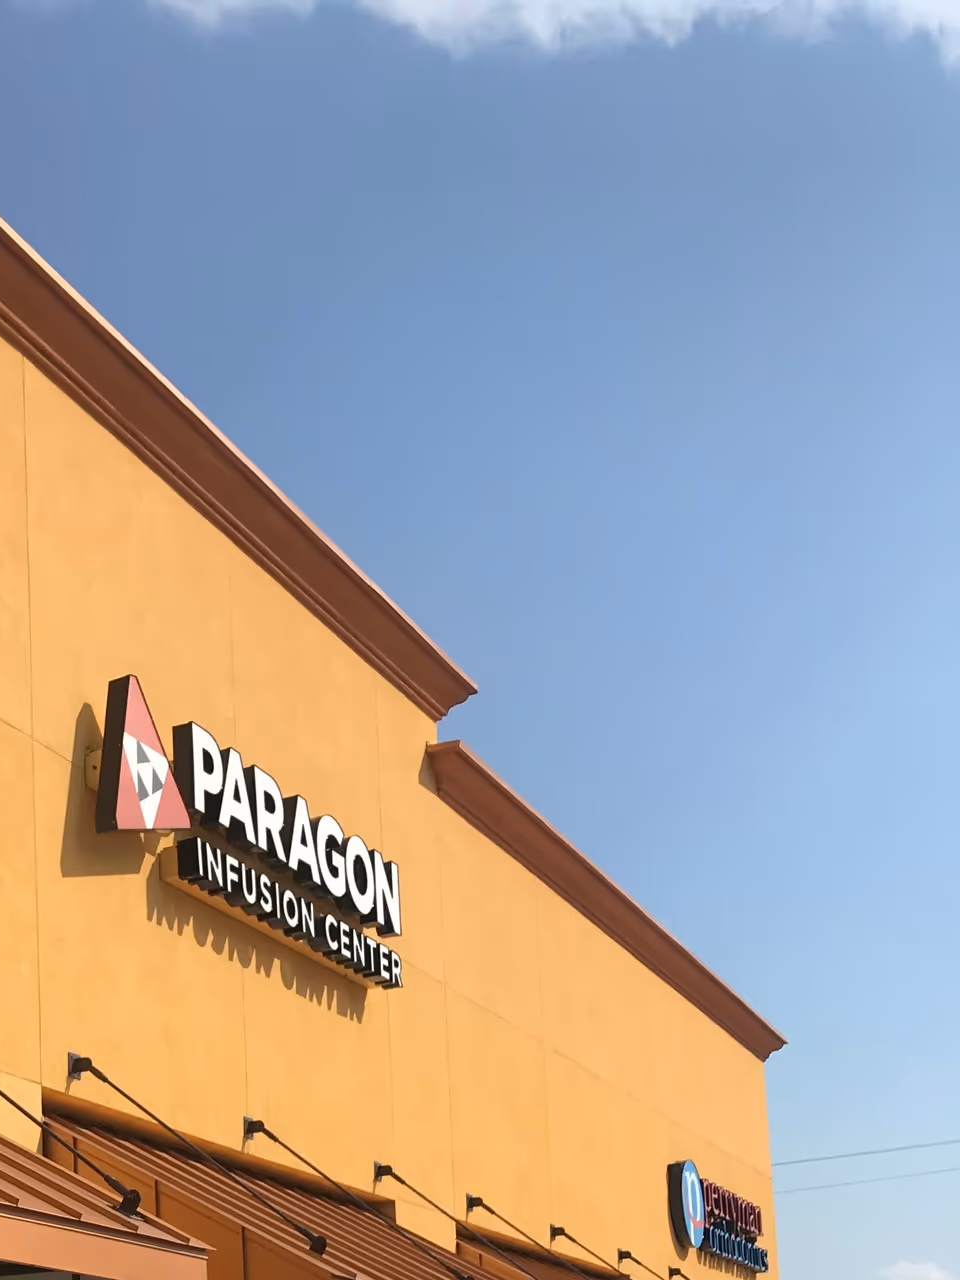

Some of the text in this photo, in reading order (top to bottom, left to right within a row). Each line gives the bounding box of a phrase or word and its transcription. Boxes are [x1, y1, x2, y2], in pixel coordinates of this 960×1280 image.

[190, 721, 402, 936] PARAGON
[195, 836, 402, 988] INFUSION CENTER
